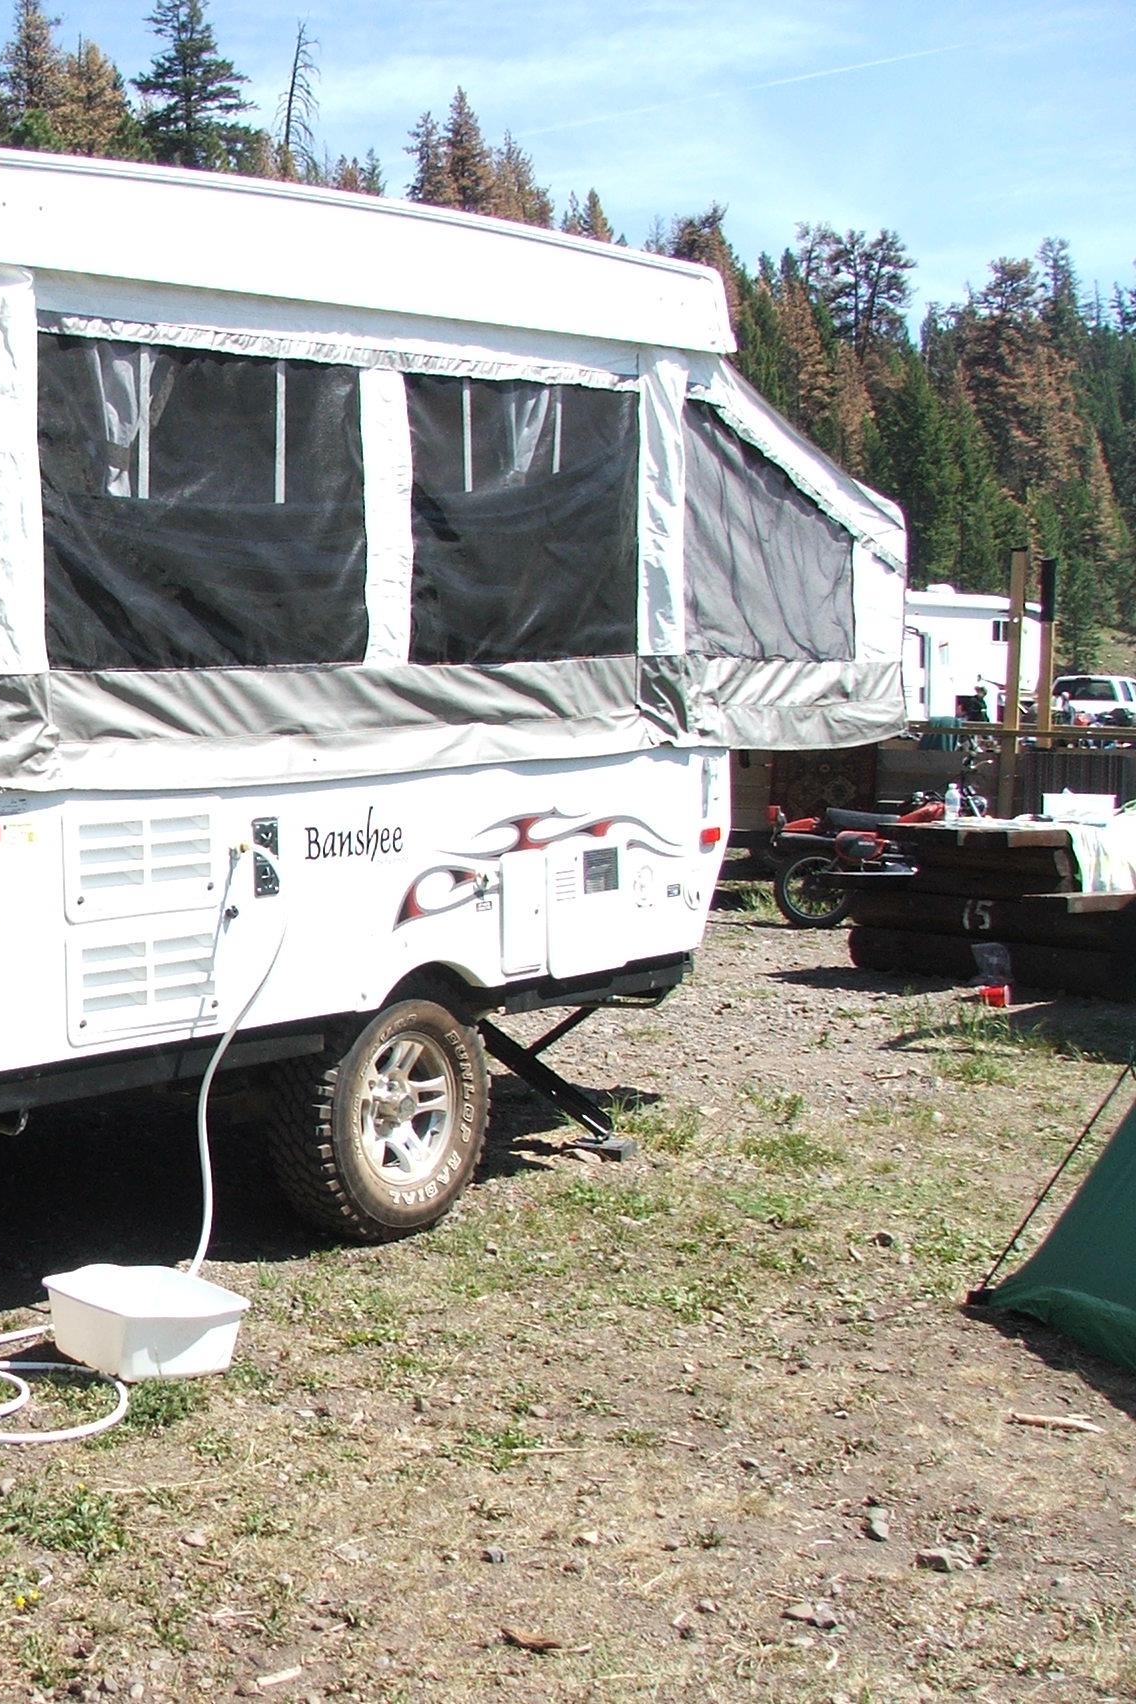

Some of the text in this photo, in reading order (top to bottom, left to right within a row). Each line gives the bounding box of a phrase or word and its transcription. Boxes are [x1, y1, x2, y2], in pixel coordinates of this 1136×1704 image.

[304, 806, 403, 862] Banshee
[963, 900, 993, 930] 15
[388, 1029, 475, 1205] DUNLOP RADIAL
